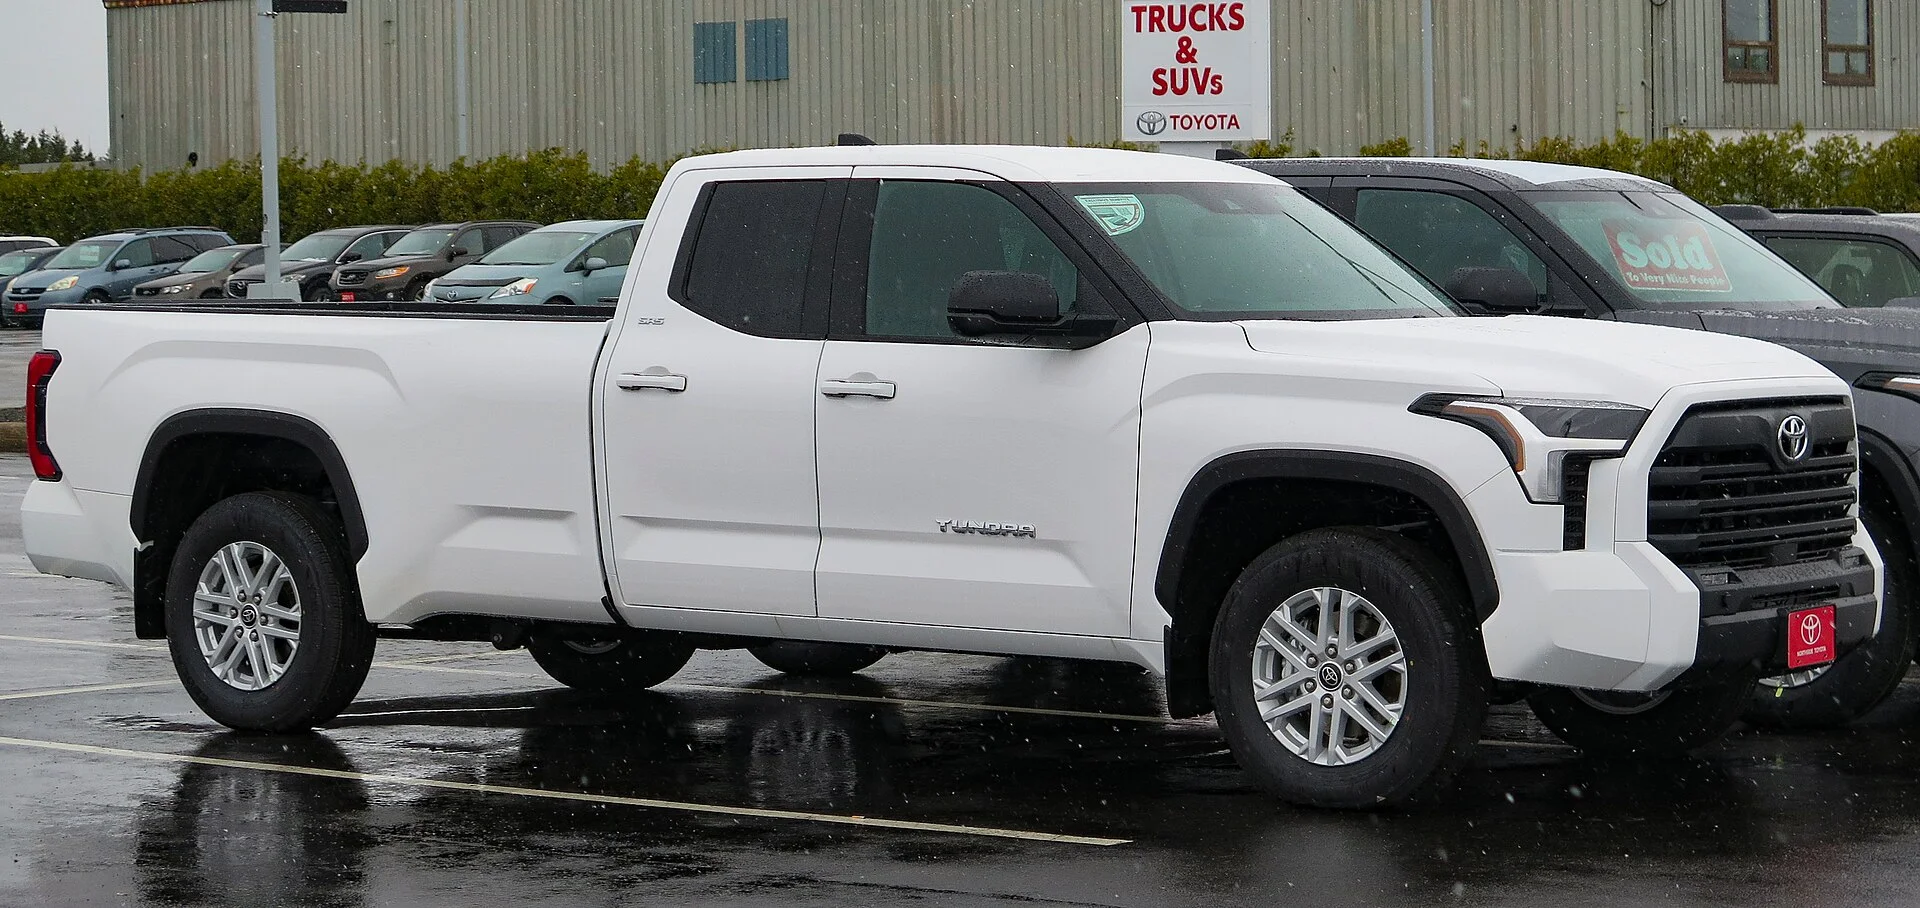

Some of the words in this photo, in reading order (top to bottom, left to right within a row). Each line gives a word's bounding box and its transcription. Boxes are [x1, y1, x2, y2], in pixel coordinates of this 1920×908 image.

[1131, 3, 1245, 33] TRUCKS
[1176, 36, 1198, 64] &
[1152, 67, 1224, 96] SUVs
[1170, 114, 1240, 130] TOYOTA
[1617, 231, 1713, 270] Sold
[1625, 271, 1639, 282] To
[1640, 272, 1665, 285] Very
[936, 519, 1036, 538] TUNDRA
